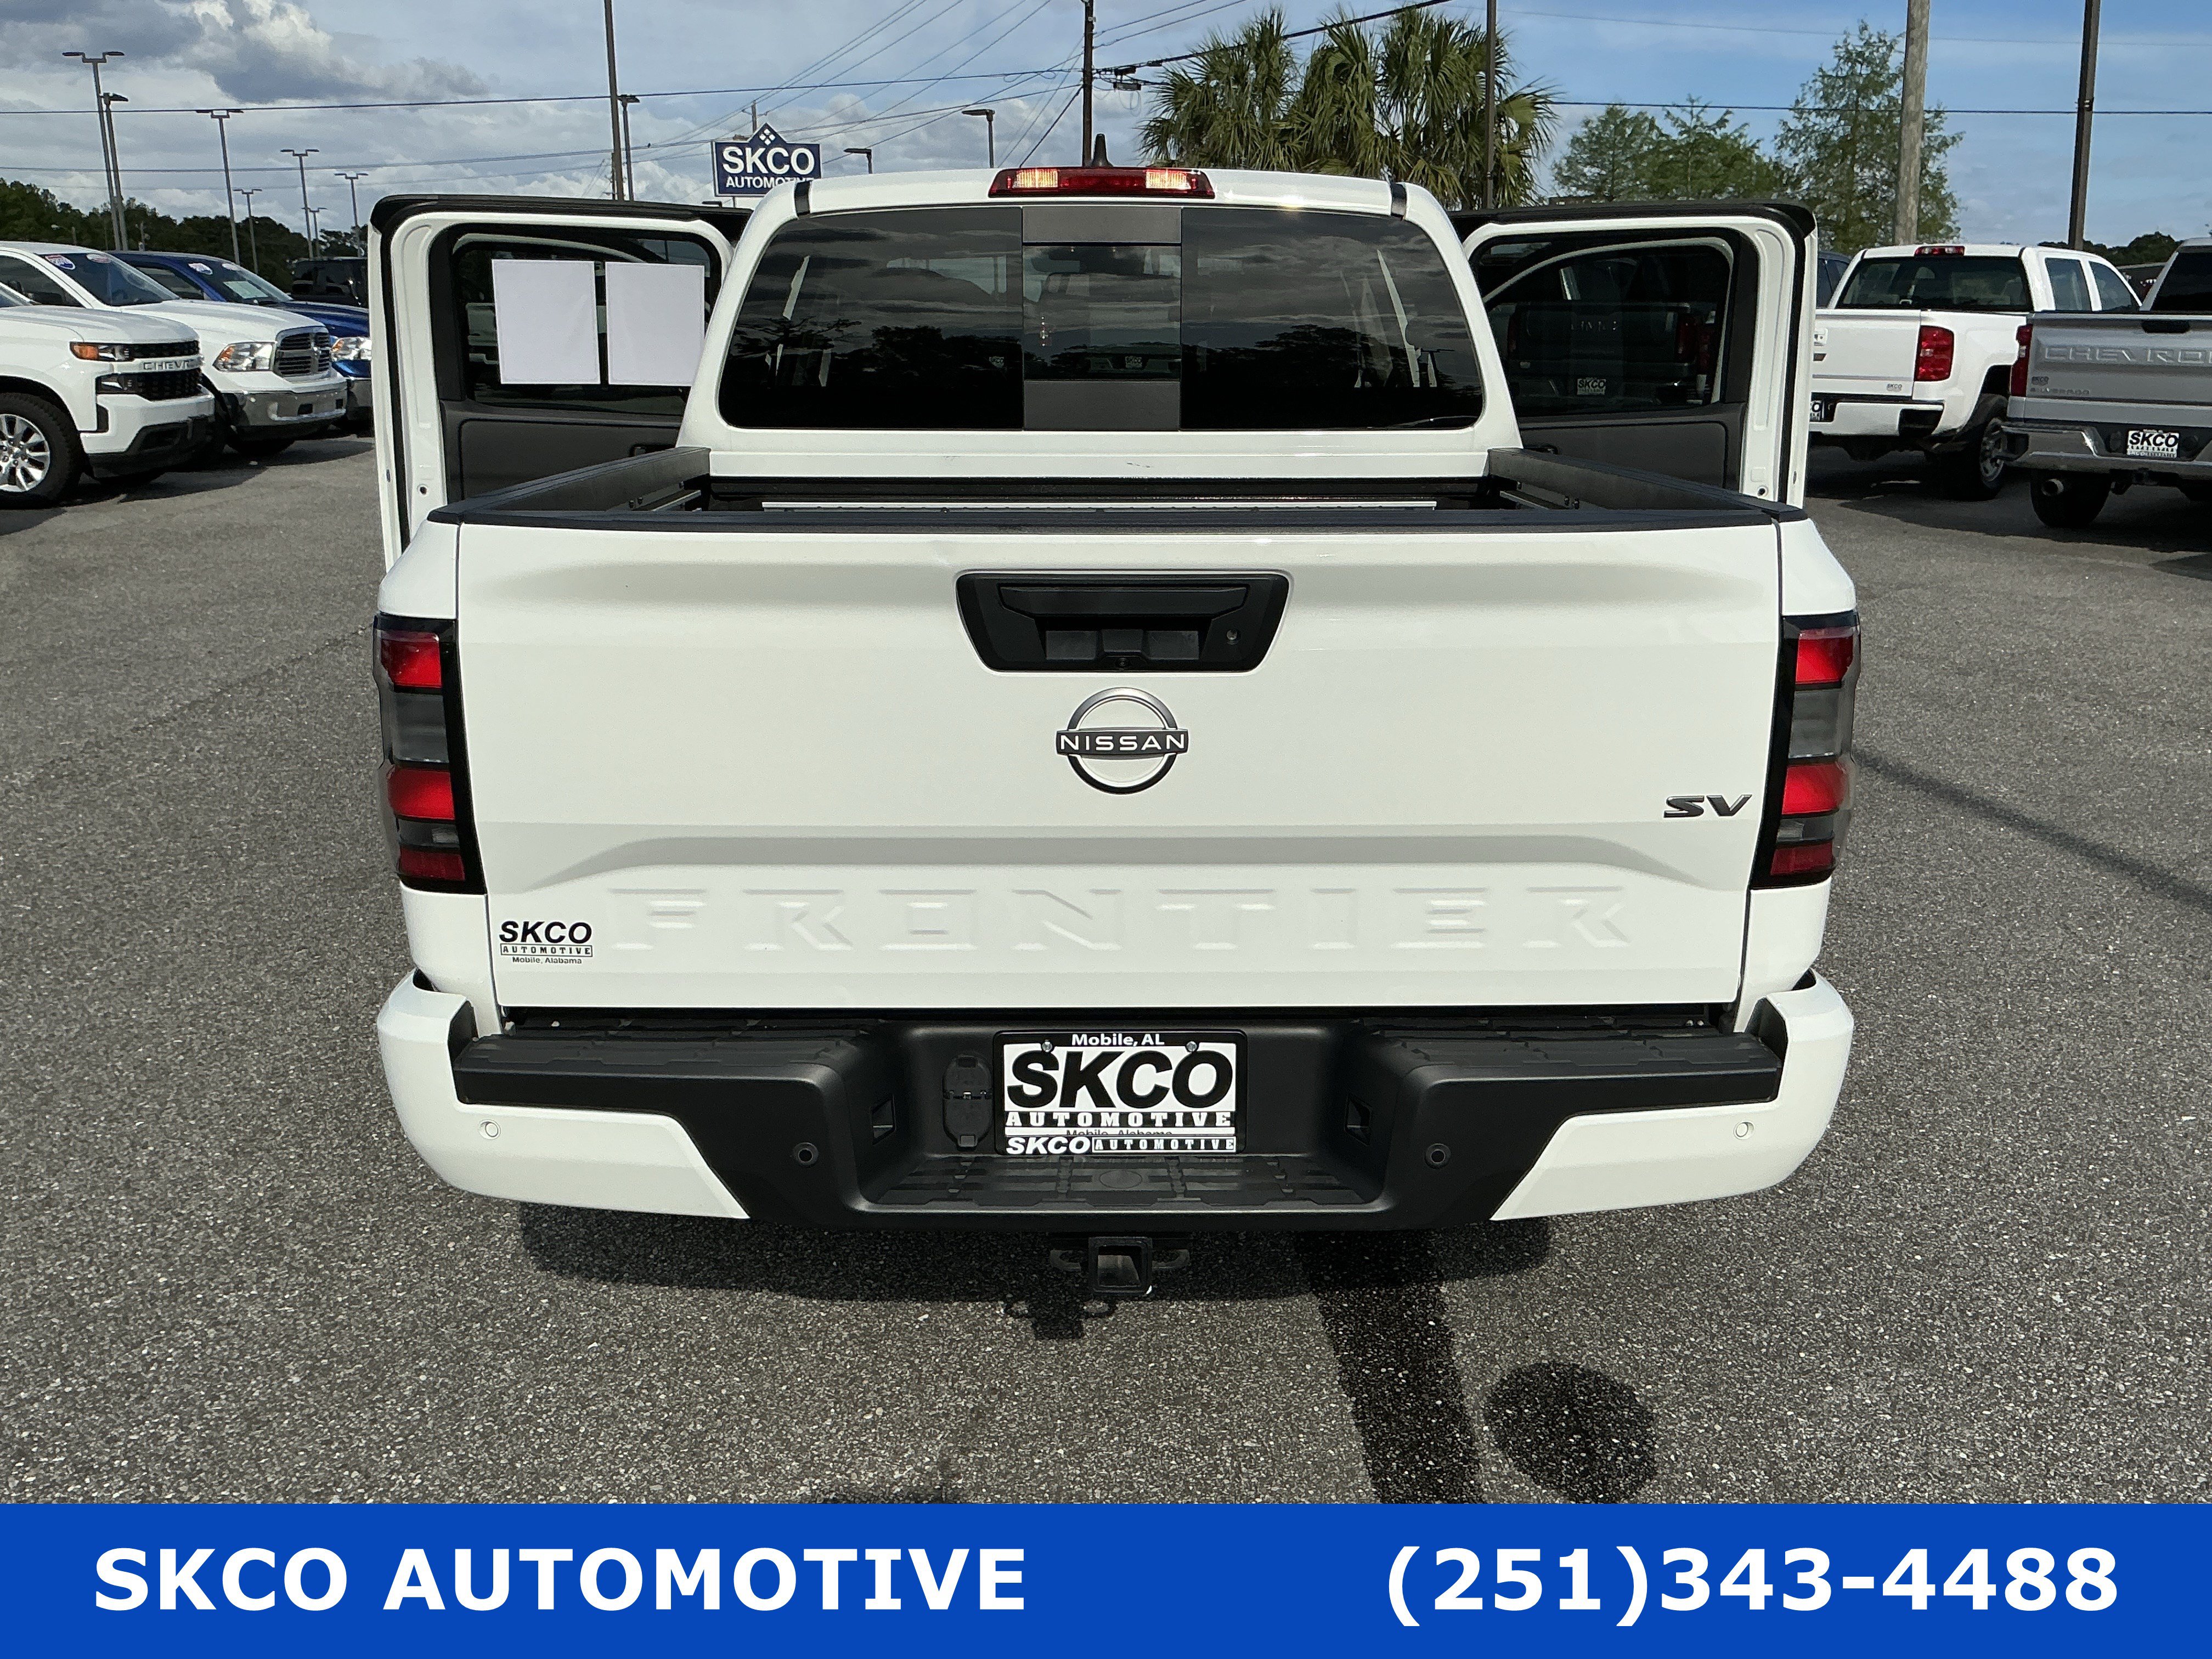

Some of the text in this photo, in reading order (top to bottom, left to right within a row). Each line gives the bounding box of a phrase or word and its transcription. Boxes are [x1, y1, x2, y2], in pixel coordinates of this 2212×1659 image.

[723, 146, 815, 175] SKCO
[2045, 347, 2212, 364] CHEVRO
[1578, 379, 1606, 389] SKCO
[2130, 432, 2179, 447] SKCO
[1060, 734, 1184, 751] NISSAN
[1663, 794, 1752, 818] SV
[607, 887, 1632, 951] FRONTIER
[499, 921, 592, 944] SKCO
[503, 946, 591, 955] AUTOMOTIVE
[1072, 1034, 1165, 1047] Mobile, AL
[1007, 1050, 1233, 1109] SKCO
[1006, 1112, 1231, 1127] AUTOMOTIVE
[1006, 1137, 1233, 1154] SKCO AUTOMOTIVE
